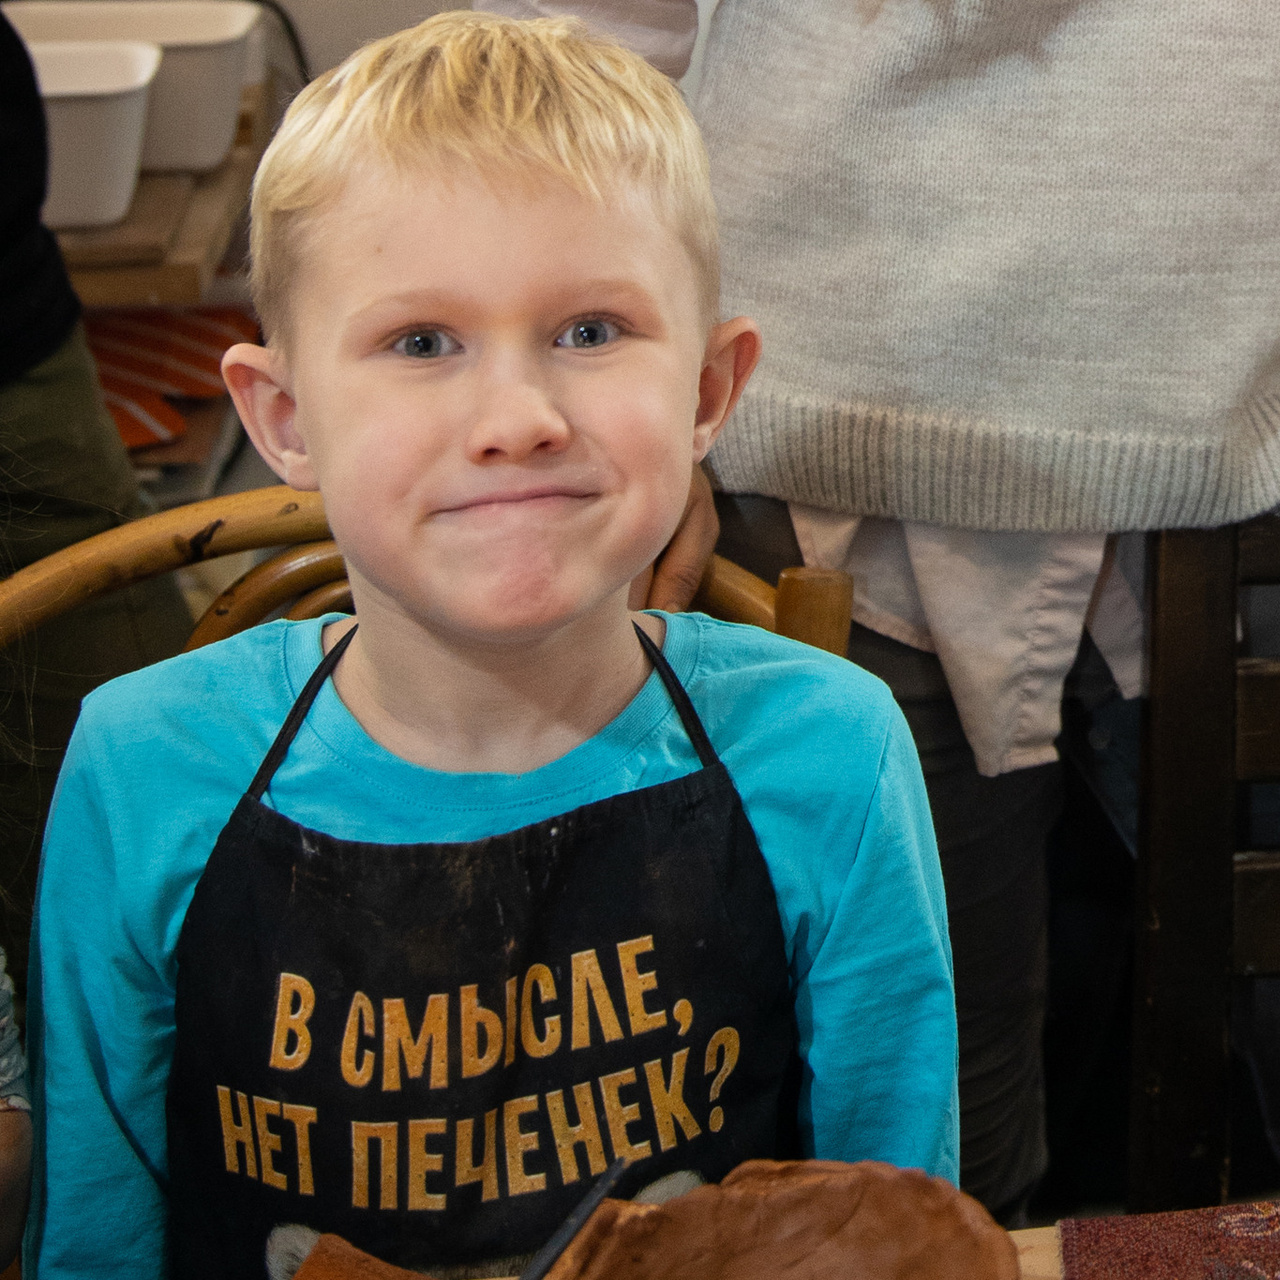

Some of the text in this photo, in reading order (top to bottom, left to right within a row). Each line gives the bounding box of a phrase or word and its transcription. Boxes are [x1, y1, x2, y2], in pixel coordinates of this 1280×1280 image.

[269, 934, 694, 1091] В СМЫСЛЕ,
[216, 1026, 741, 1212] НЕТ ПЕЧЕНЕК?
